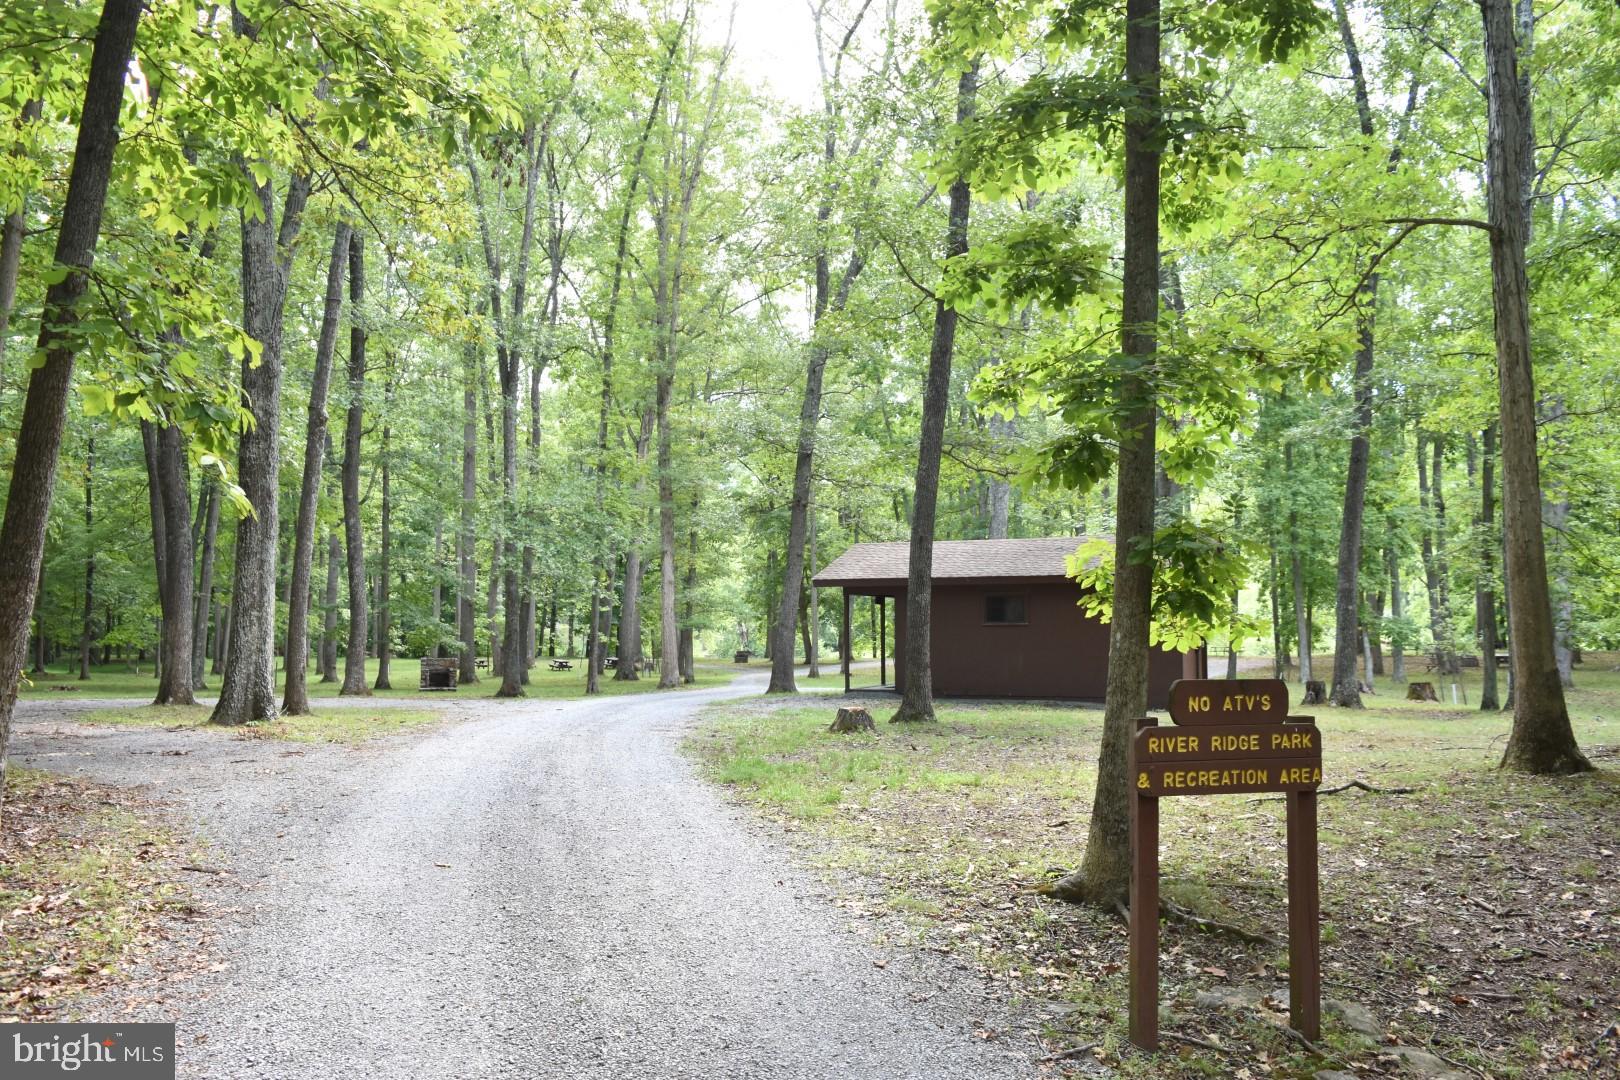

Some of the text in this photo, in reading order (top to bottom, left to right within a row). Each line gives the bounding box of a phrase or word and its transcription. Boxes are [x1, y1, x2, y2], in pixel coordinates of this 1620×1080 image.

[1188, 695, 1272, 712] NO ATV'S
[1148, 733, 1313, 753] RIVER RIDGE PARK
[1137, 768, 1322, 789] & RECREATION AREA
